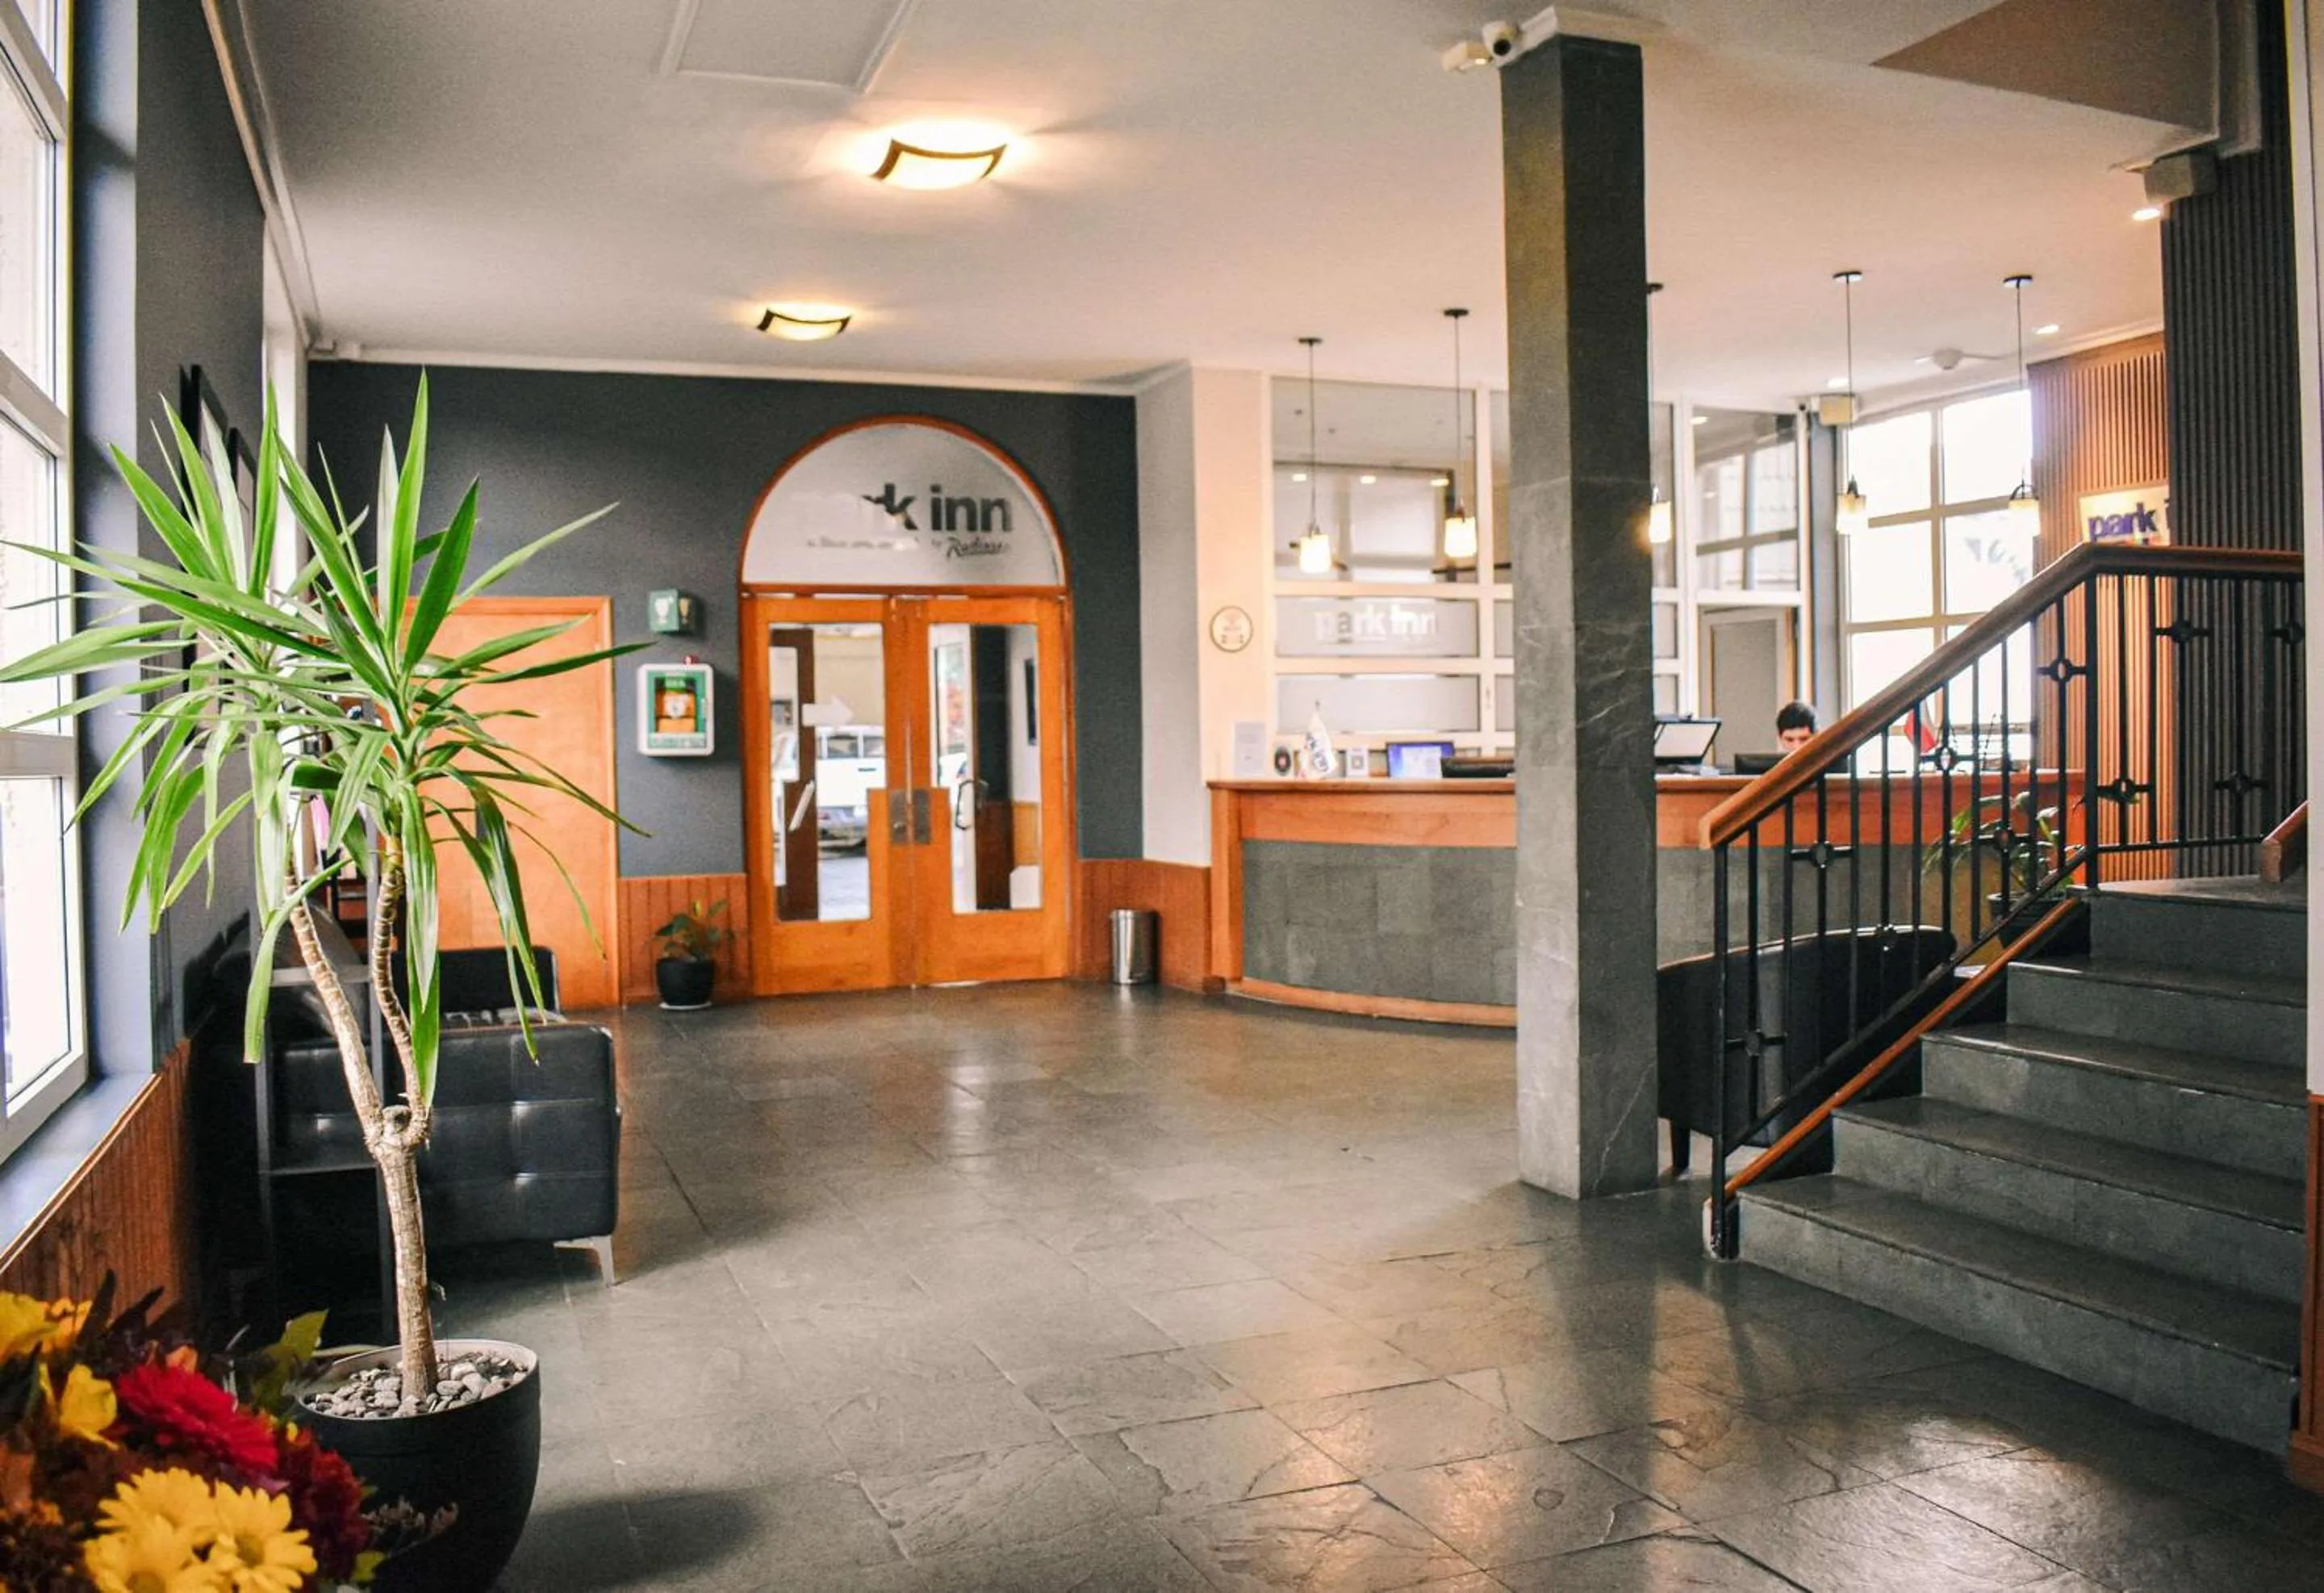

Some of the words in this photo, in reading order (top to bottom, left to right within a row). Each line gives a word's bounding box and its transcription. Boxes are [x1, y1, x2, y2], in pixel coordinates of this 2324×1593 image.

[930, 485, 1013, 531] inn
[2088, 502, 2158, 543] park
[1315, 604, 1386, 641] park
